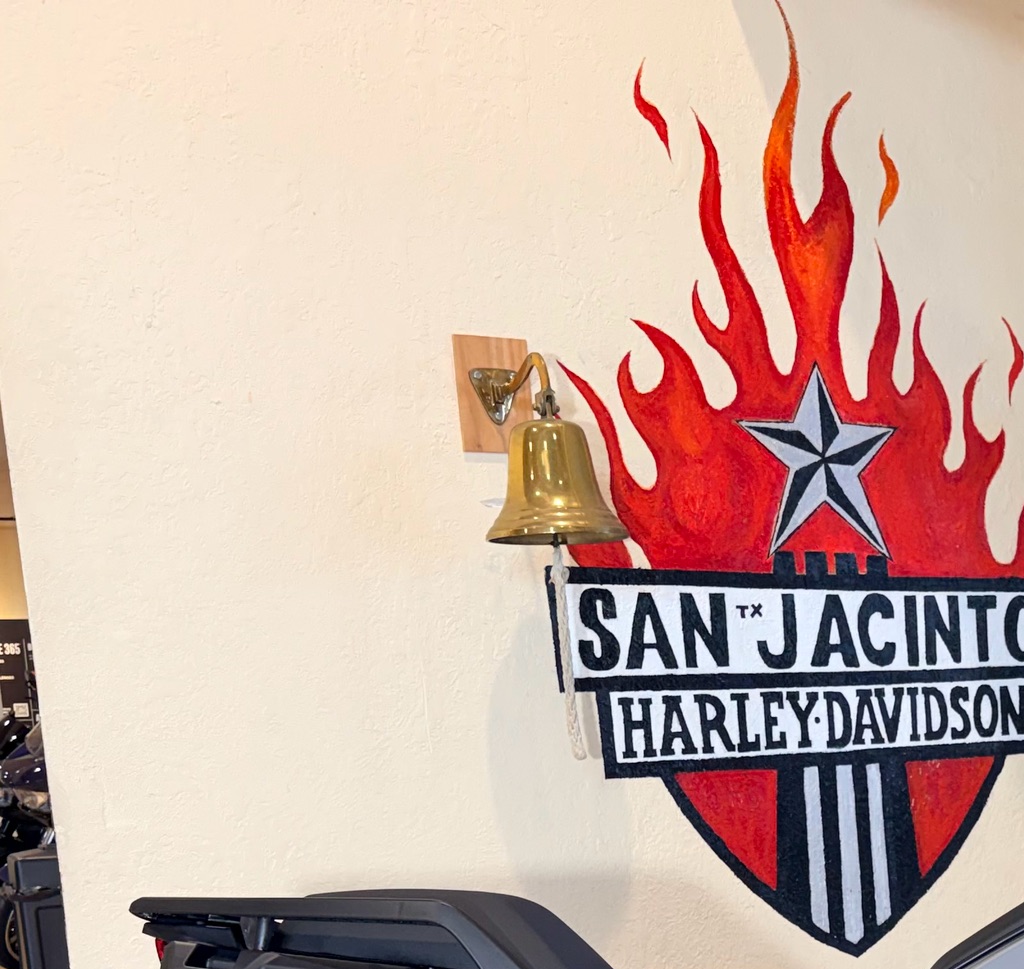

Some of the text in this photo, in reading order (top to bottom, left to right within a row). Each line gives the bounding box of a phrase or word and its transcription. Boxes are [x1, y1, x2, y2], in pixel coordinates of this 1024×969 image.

[3, 642, 21, 655] 365
[578, 587, 730, 671] SAN
[736, 603, 764, 619] TX
